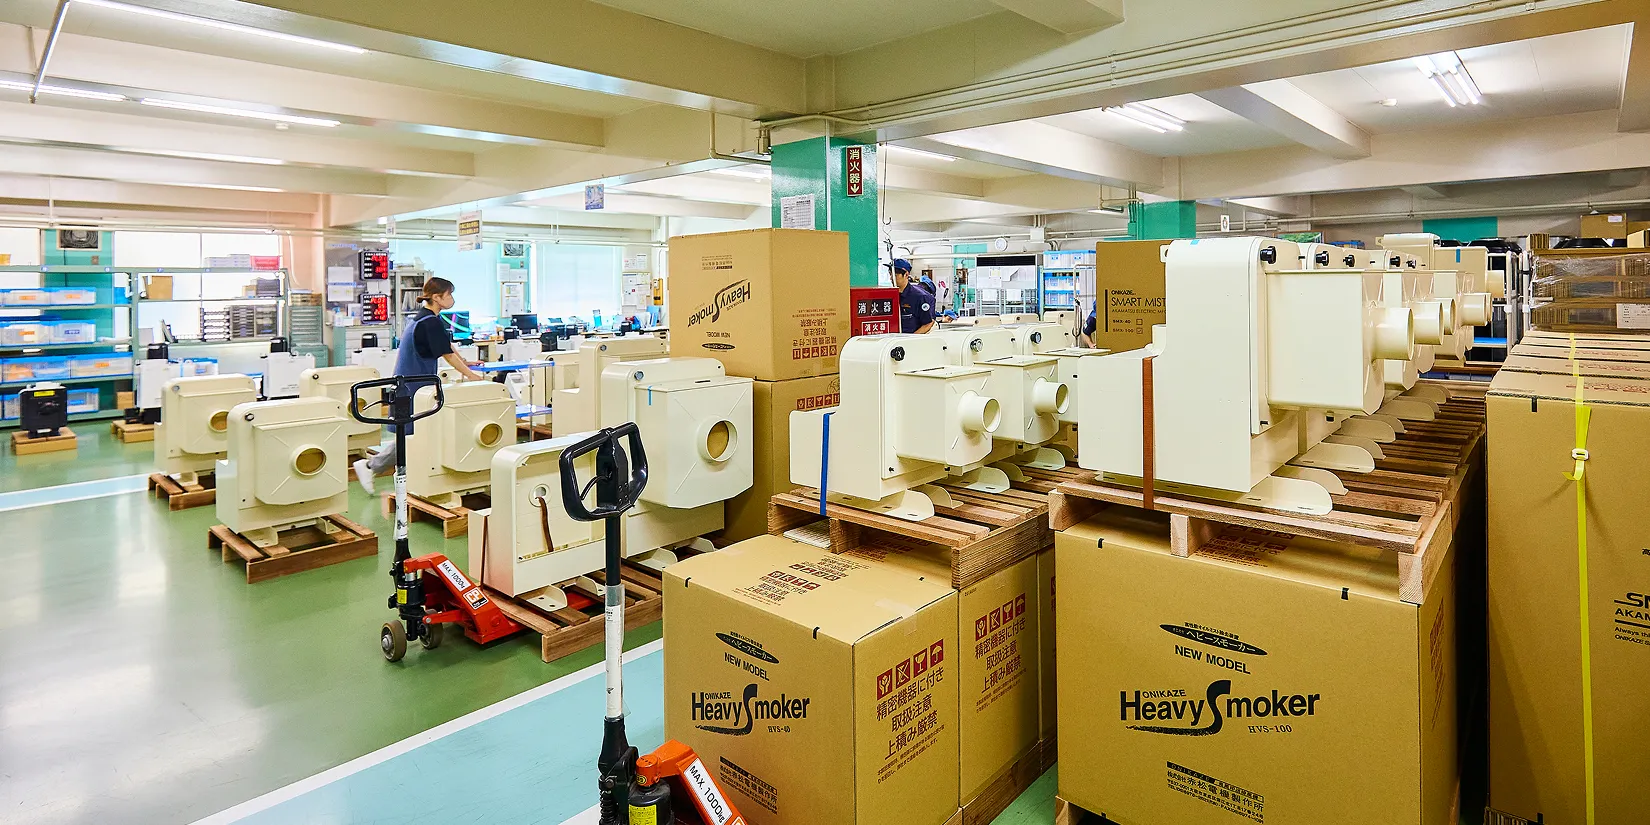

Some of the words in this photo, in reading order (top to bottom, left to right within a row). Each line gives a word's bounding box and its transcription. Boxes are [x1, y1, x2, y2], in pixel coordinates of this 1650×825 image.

[849, 149, 861, 184] 消火器
[858, 301, 892, 314] 消火器
[1111, 297, 1142, 307] SMART
[864, 322, 886, 332] 消火器
[975, 617, 1026, 660] 精密機器に付き
[1186, 629, 1256, 652] ヘビースモーカー
[1615, 626, 1639, 635] Always
[1615, 635, 1644, 645] ONIKAZE
[724, 652, 741, 668] NEW
[743, 660, 770, 681] MODEL
[986, 640, 1017, 670] 取扱注意
[1175, 645, 1202, 661] NEW
[1206, 653, 1251, 675] MODEL
[981, 655, 1022, 694] 上積み厳禁
[704, 691, 731, 700] ONIKAZE
[876, 666, 944, 721] 精密機器に付き
[1142, 689, 1186, 699] ONIKAZE
[891, 693, 933, 733] 取扱注意
[767, 725, 791, 733] HVS-40
[884, 709, 938, 761] 上積み厳禁
[1248, 724, 1292, 733] HVS-100
[689, 765, 704, 790] MAX.
